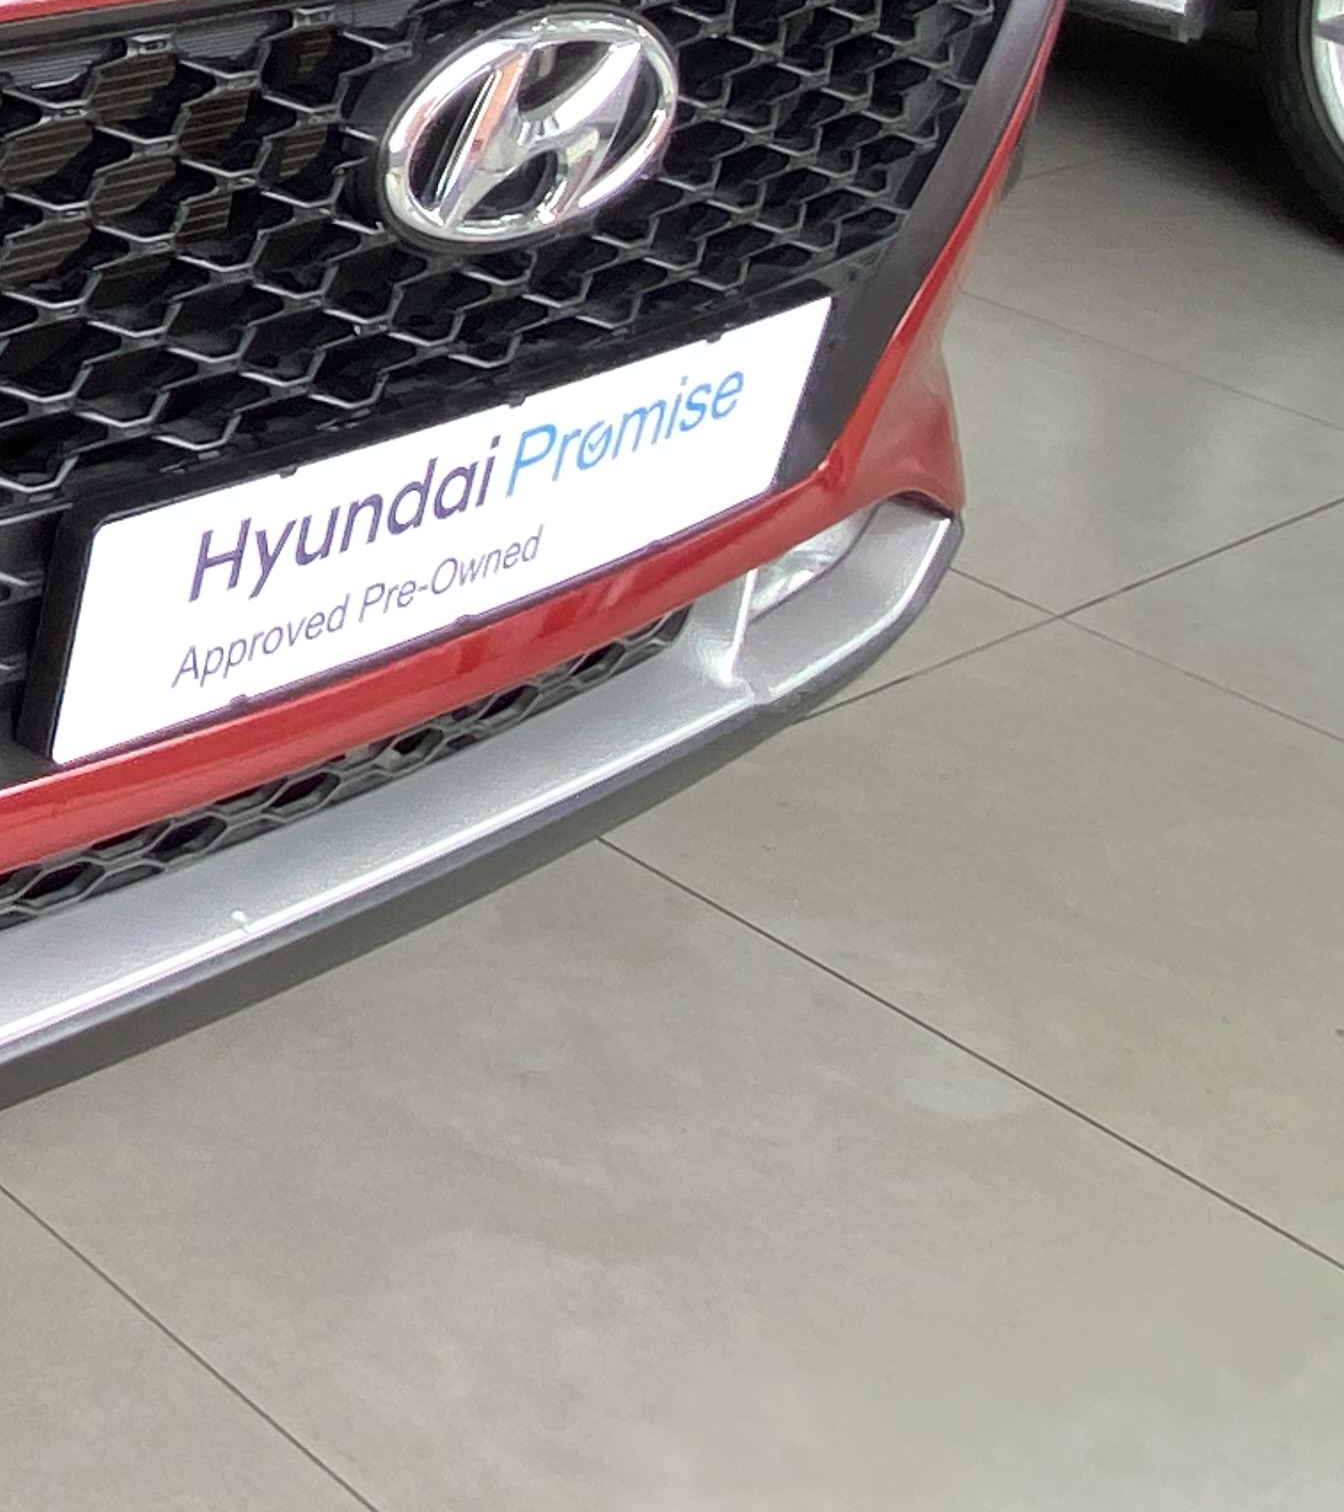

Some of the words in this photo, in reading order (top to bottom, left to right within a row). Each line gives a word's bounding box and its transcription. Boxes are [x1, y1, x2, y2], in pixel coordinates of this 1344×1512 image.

[187, 434, 502, 604] Hyundai
[505, 370, 744, 499] Promise
[170, 592, 351, 689] Approved
[357, 523, 545, 624] Pre-Owned
